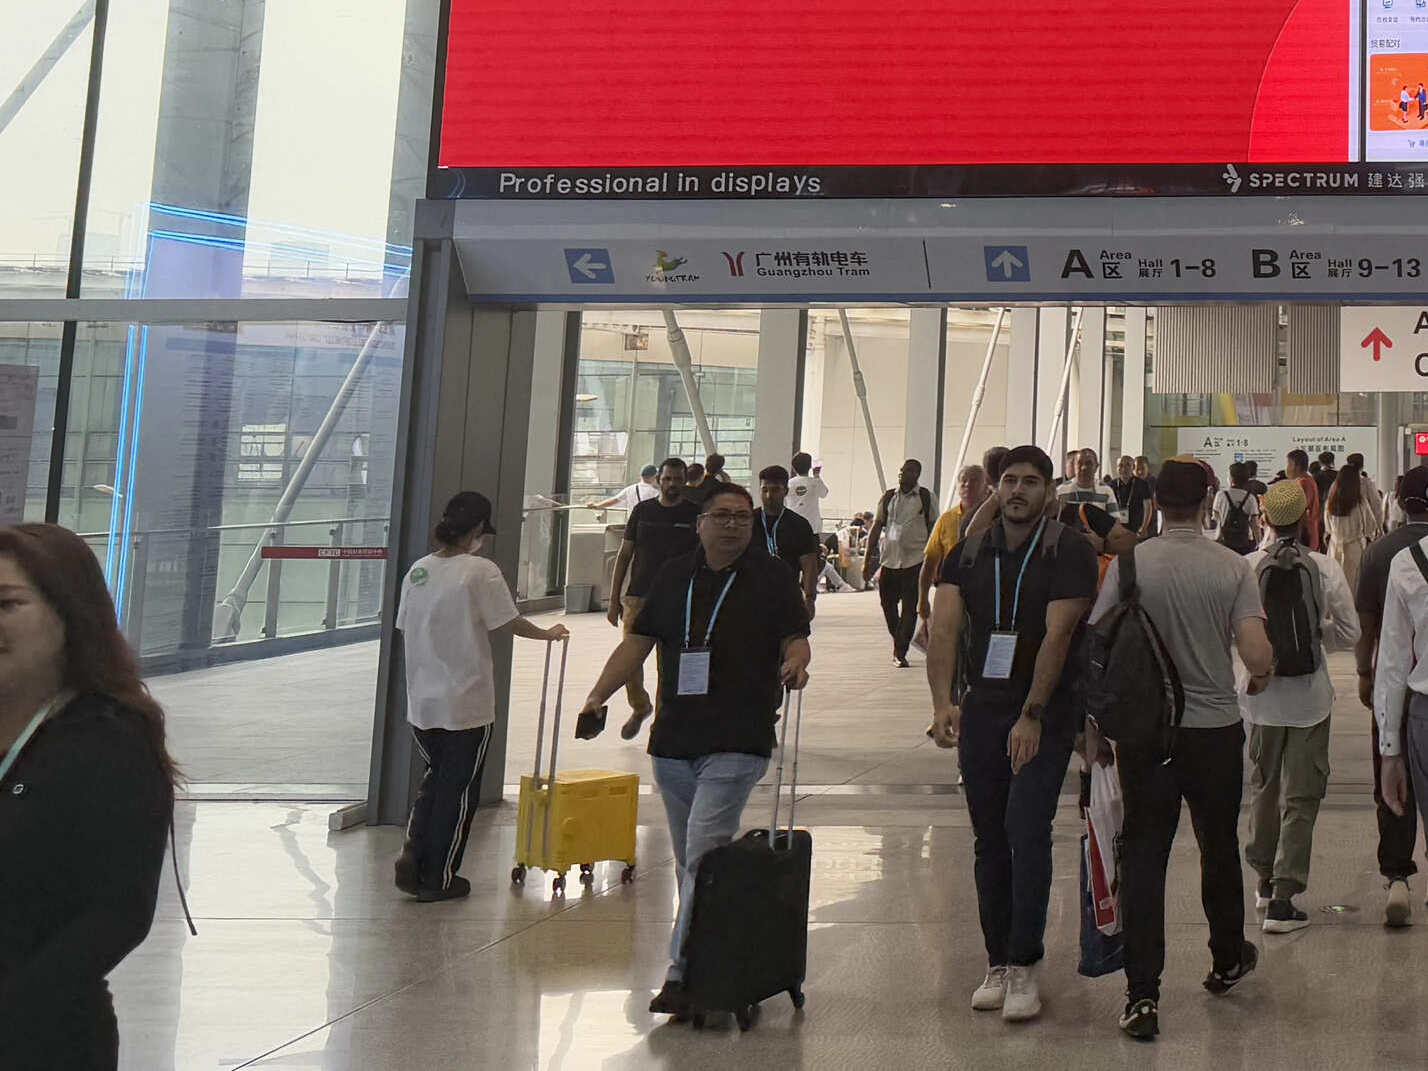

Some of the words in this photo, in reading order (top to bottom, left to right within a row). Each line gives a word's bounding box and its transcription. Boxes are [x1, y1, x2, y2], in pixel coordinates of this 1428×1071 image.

[500, 172, 668, 195] Professional
[677, 172, 699, 193] in
[712, 173, 822, 196] displays
[1250, 173, 1359, 187] SPECTRUM
[1368, 173, 1425, 188] 建达强
[755, 250, 869, 267] 广州有轨电车
[1099, 250, 1132, 260] Area
[1289, 250, 1322, 260] Area
[1061, 249, 1094, 279] A
[1138, 259, 1163, 267] Hall
[1170, 259, 1217, 278] 1-8
[1251, 249, 1281, 279] B
[1328, 259, 1352, 267] Hall
[1358, 259, 1421, 278] 9-13
[756, 267, 833, 278] Guangzhou
[837, 267, 870, 276] Tram
[1103, 262, 1122, 279] 区
[1138, 268, 1164, 278] 展厅
[1292, 262, 1312, 279] 区
[1327, 268, 1353, 278] 展厅
[1203, 437, 1213, 447] A
[1292, 436, 1316, 444] Layout
